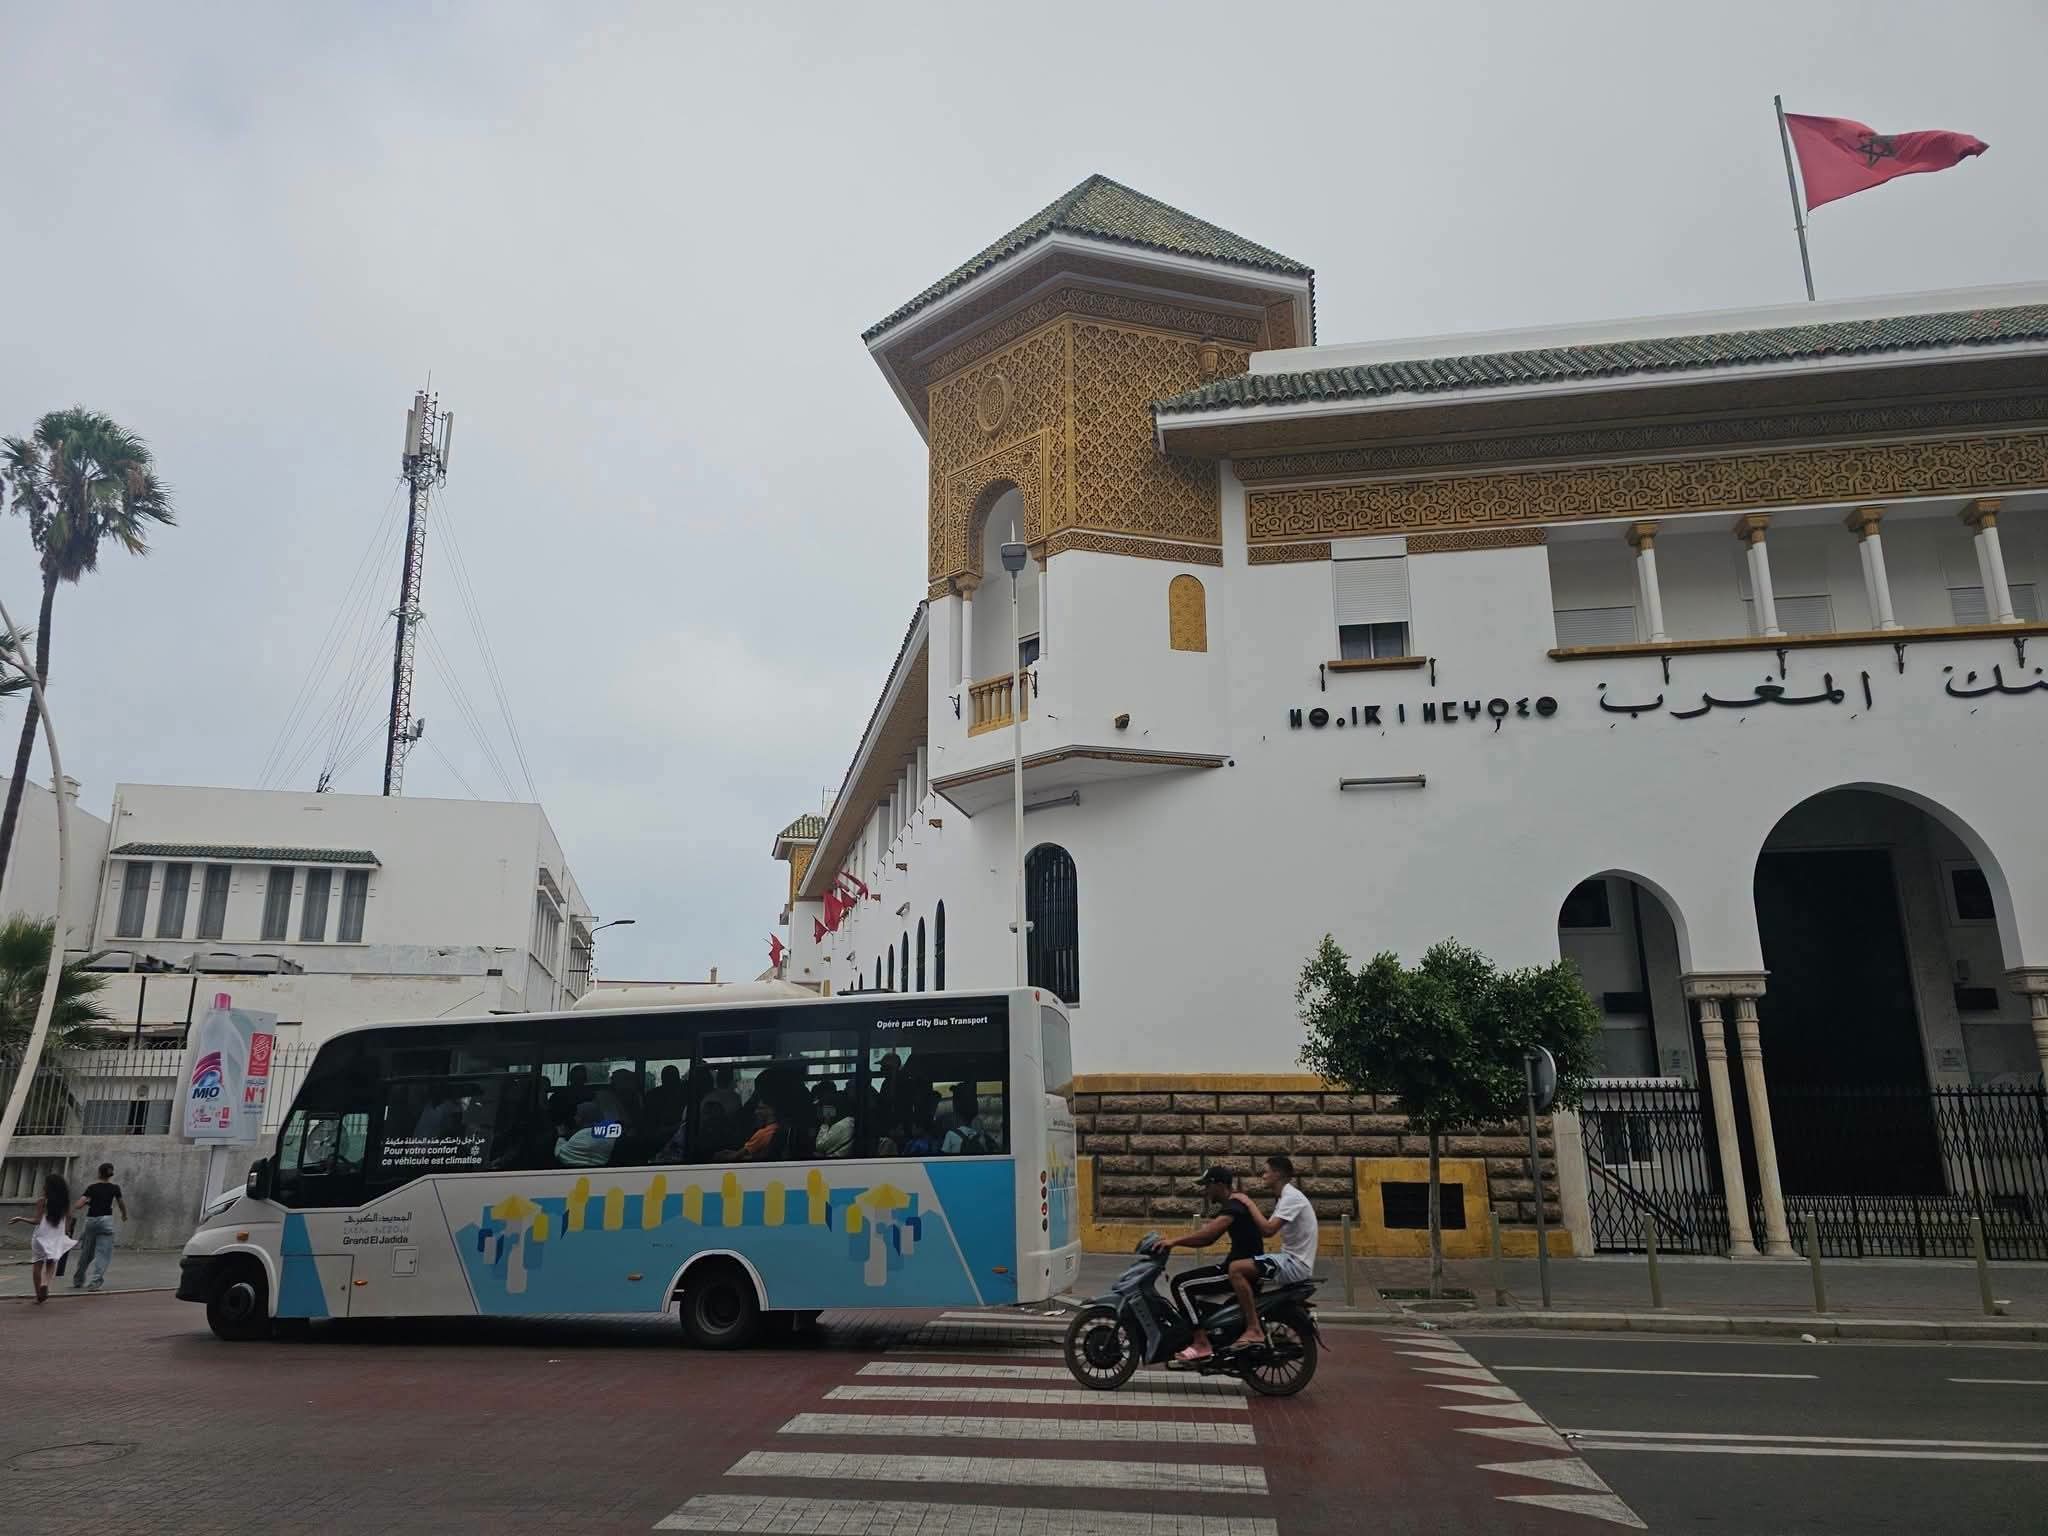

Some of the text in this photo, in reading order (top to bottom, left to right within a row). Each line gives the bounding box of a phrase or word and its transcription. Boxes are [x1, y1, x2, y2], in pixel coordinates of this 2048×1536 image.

[902, 1020, 915, 1029] par
[916, 1018, 931, 1028] City
[933, 1018, 948, 1026] Bus
[950, 1016, 988, 1025] Transport
[192, 1087, 220, 1099] MIO
[383, 1146, 458, 1155] Pour votre confort
[381, 1158, 393, 1166] ce
[430, 1157, 444, 1165] est
[342, 1234, 409, 1245] Grand El Jadida
